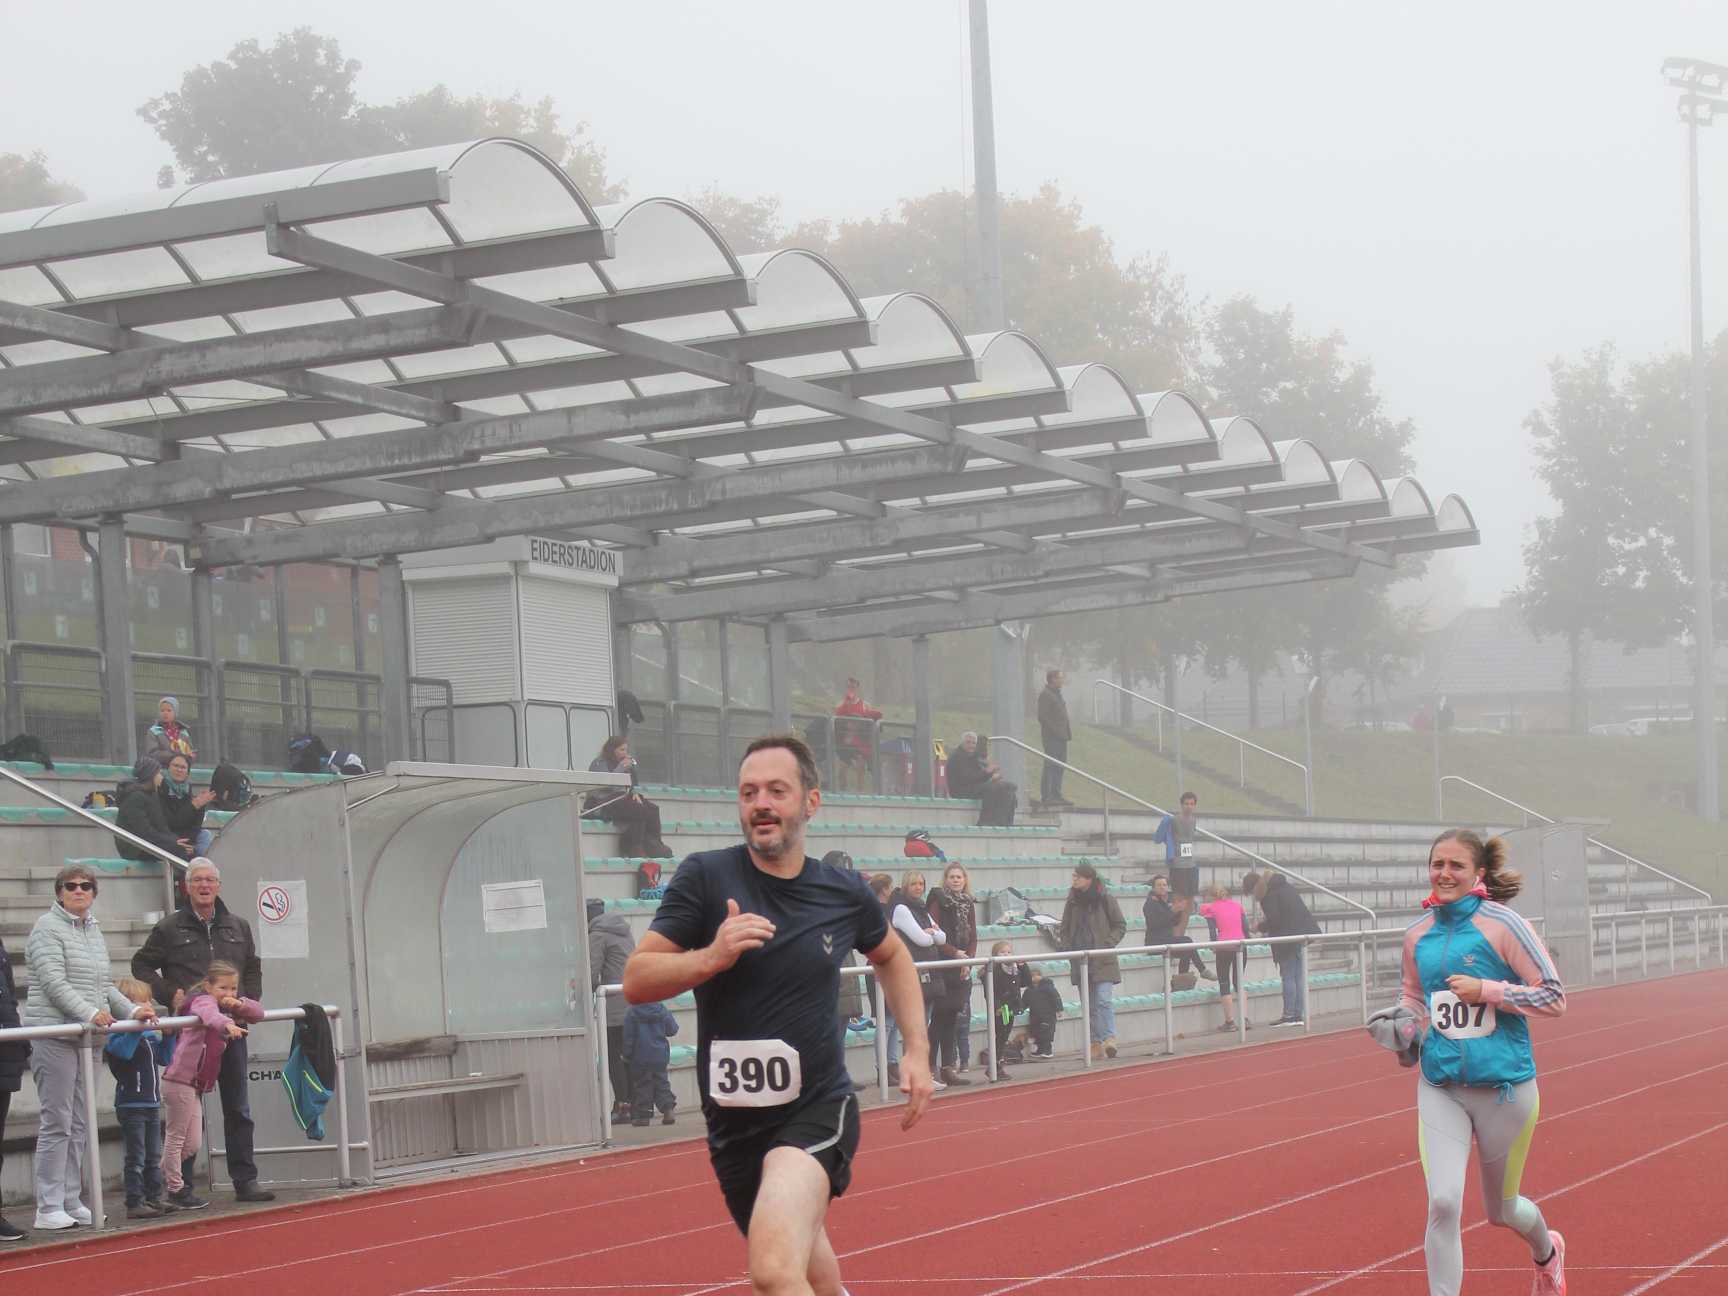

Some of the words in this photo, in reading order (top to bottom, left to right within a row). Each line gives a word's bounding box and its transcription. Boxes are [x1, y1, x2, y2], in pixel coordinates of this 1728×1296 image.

[531, 539, 616, 573] EIDERSTADION
[1437, 1002, 1487, 1030] 307
[718, 1056, 791, 1093] 390
